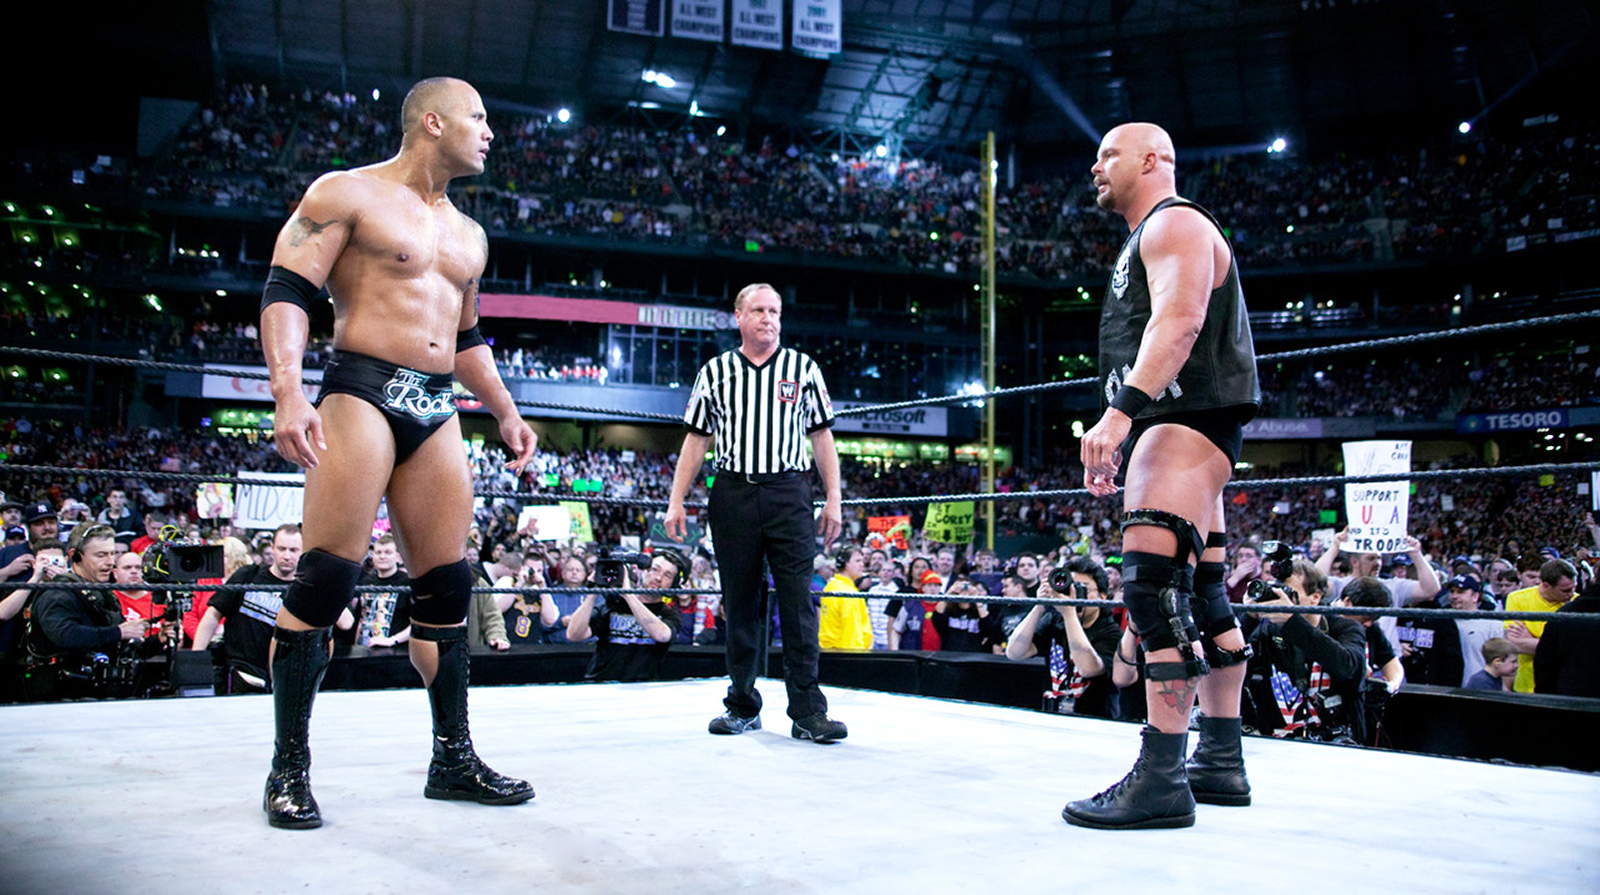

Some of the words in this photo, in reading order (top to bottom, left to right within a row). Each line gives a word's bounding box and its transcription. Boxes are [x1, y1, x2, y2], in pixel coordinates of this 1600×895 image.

[841, 404, 927, 424] Microsoft
[1486, 411, 1562, 430] TESORO
[1352, 489, 1400, 502] SUPPORT
[935, 512, 972, 525] COREY
[1353, 537, 1410, 552] TROOPS
[516, 616, 531, 638] 8
